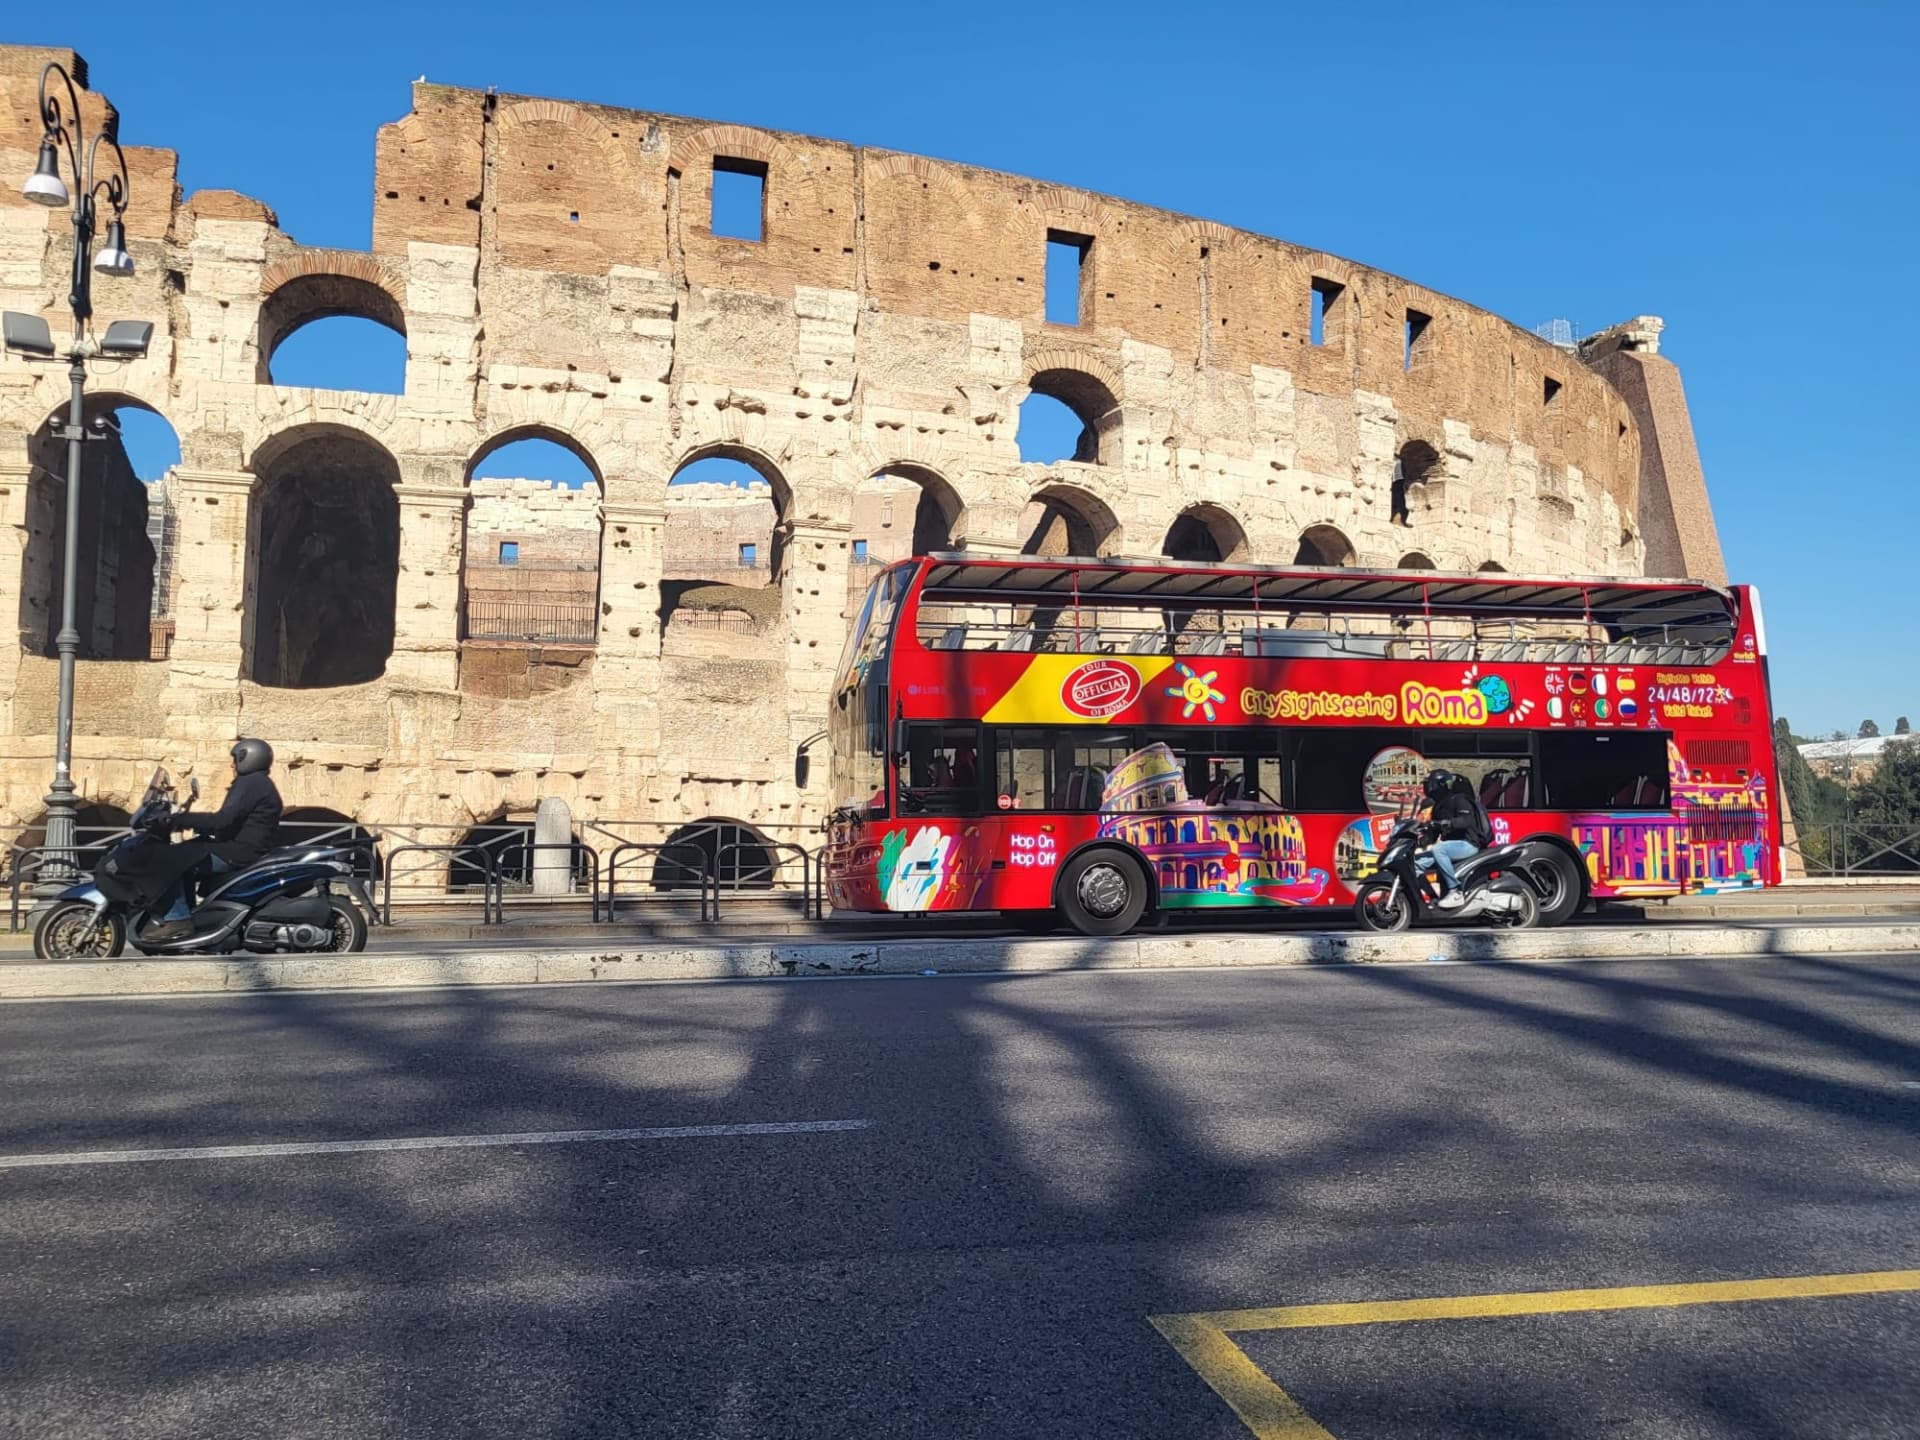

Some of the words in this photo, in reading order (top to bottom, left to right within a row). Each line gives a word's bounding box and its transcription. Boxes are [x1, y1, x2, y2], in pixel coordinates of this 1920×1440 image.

[1075, 677, 1127, 700] OFFICIAL
[1647, 686, 1714, 703] 24/48/72
[1090, 708, 1103, 717] OF
[1104, 699, 1129, 715] ROMA
[1240, 687, 1397, 721] CitySightseeing
[1494, 818, 1508, 831] On
[1010, 833, 1035, 849] Hop
[1038, 833, 1055, 848] On
[1494, 832, 1511, 845] Off
[1010, 851, 1035, 867] Hop
[1038, 851, 1057, 866] Off
